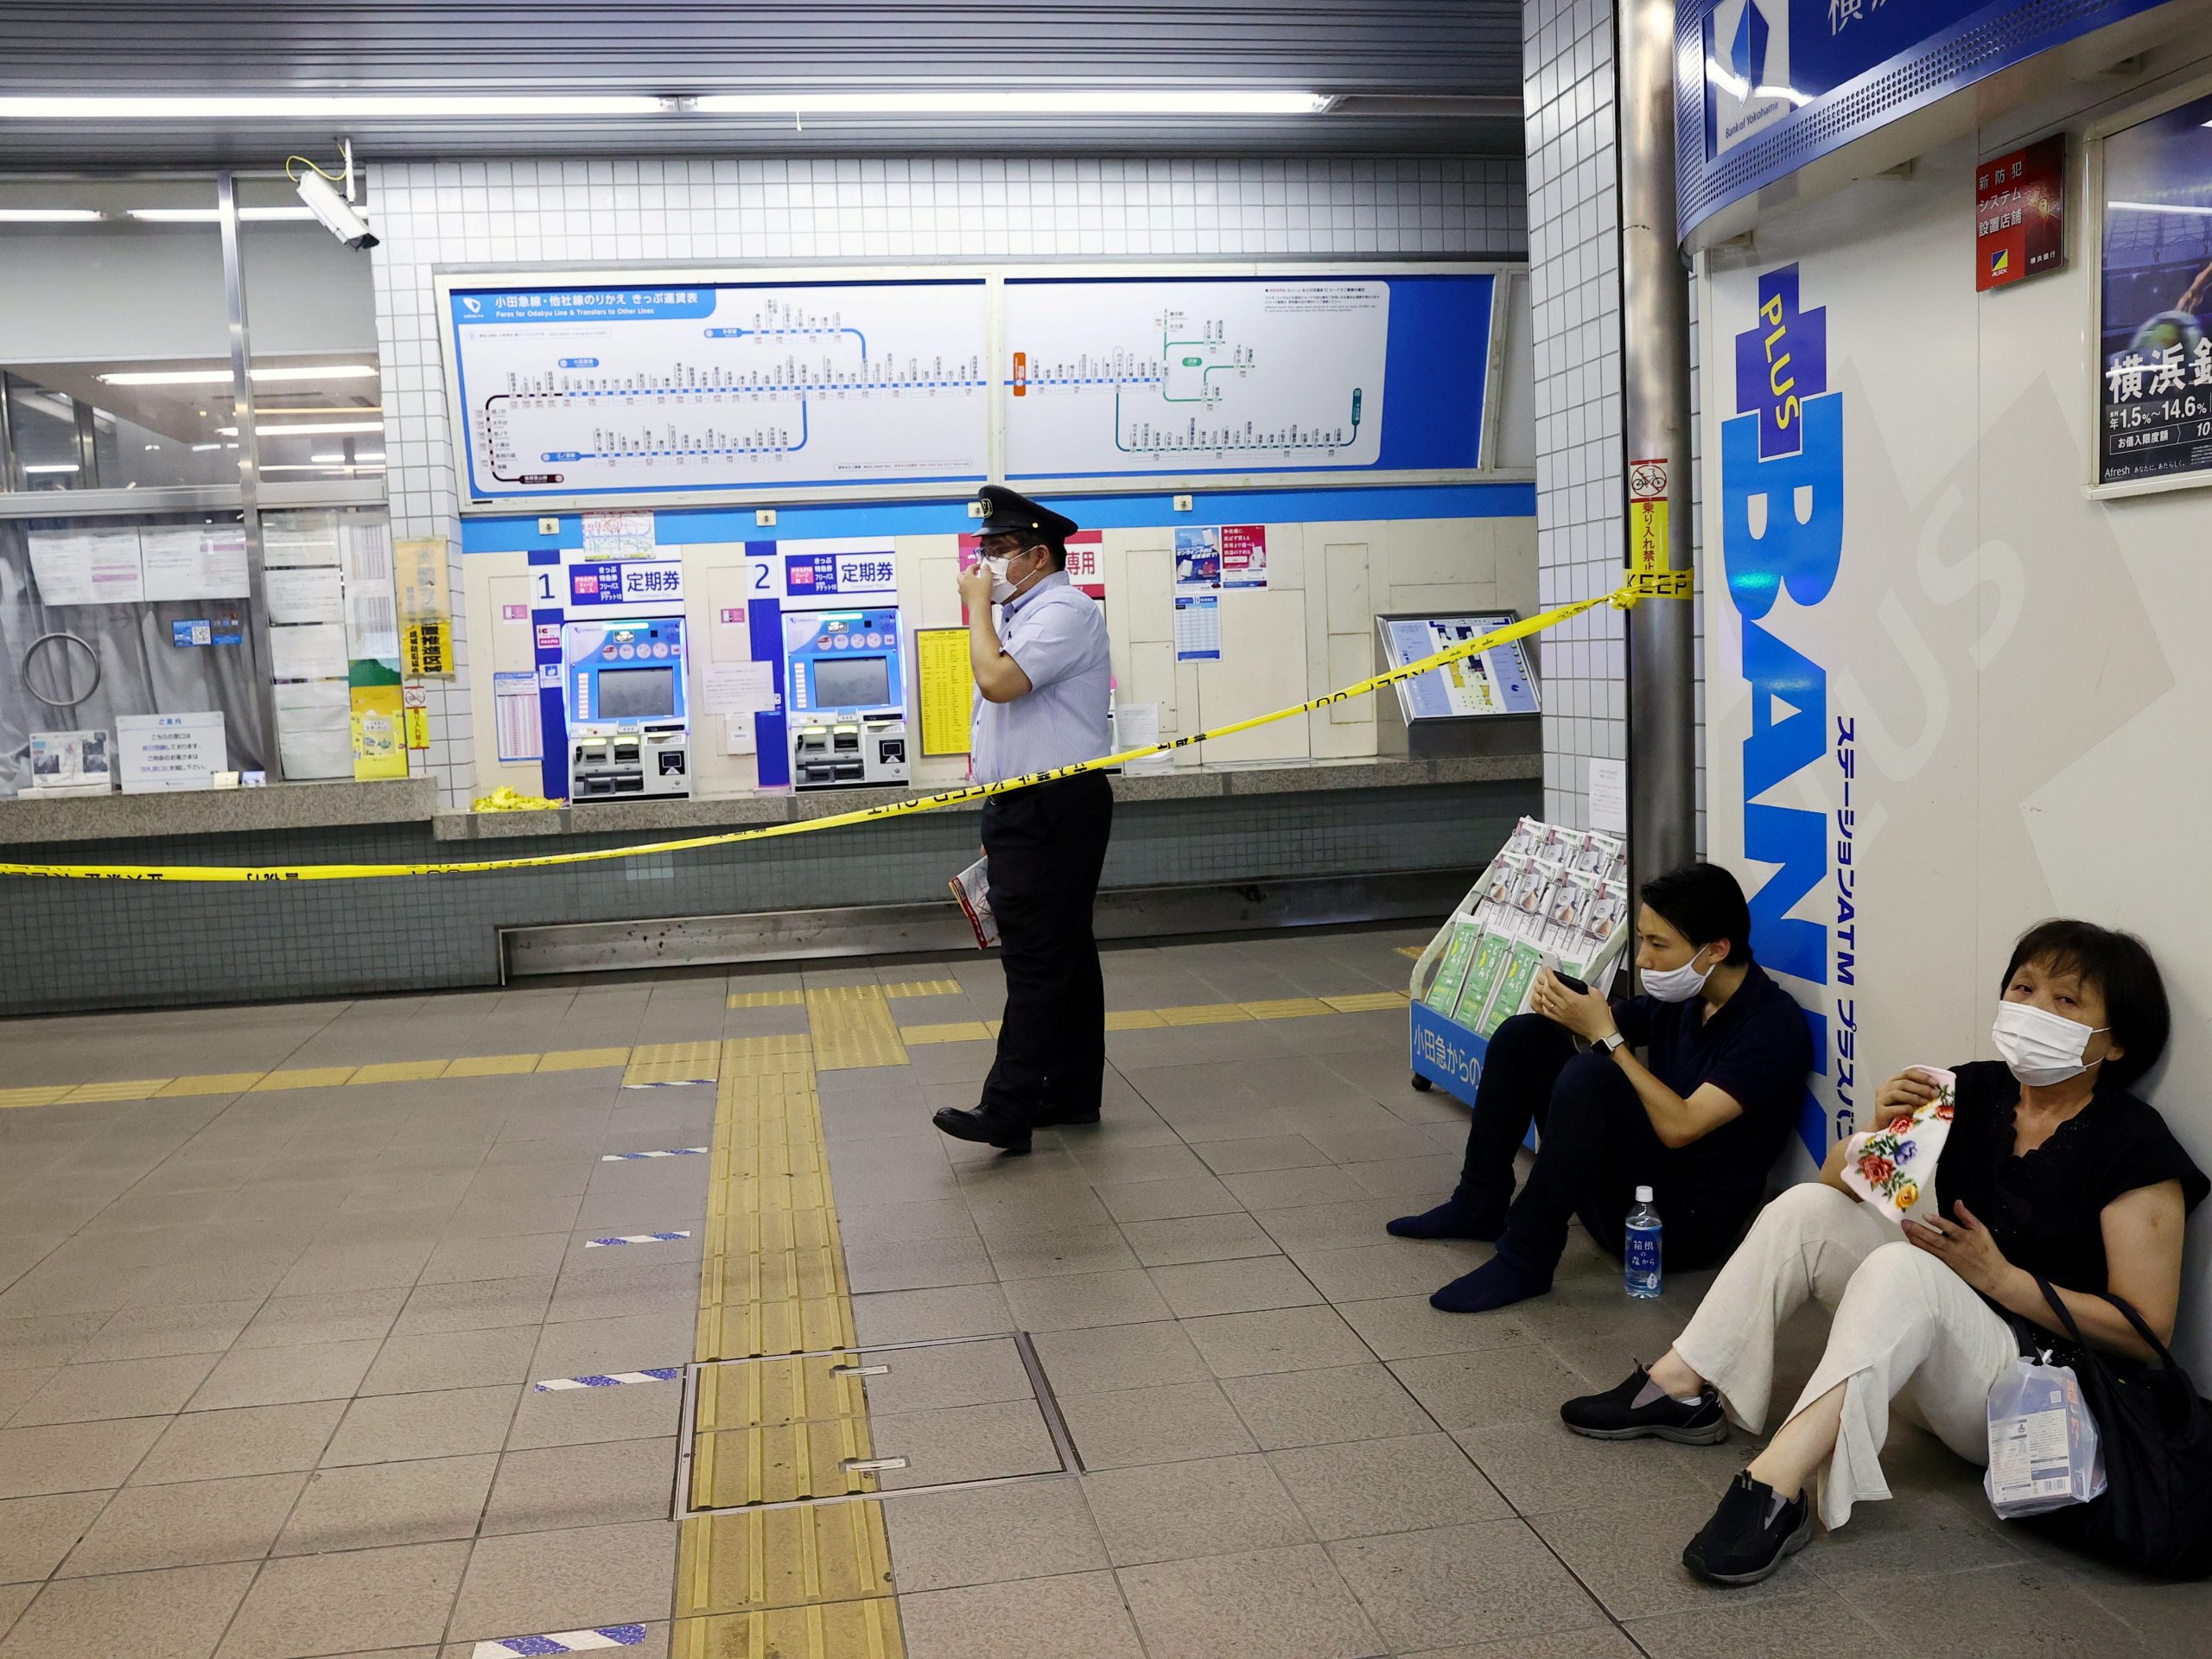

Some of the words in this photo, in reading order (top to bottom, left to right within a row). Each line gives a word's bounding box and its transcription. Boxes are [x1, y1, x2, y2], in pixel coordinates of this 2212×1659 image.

[1726, 123, 1738, 138] Bank
[1739, 117, 1745, 130] of
[1746, 102, 1778, 124] Yokohama
[1979, 162, 2022, 191] 新防犯
[1980, 187, 2022, 213] システム
[1979, 208, 2022, 237] 設置店舗
[527, 309, 553, 319] Odakyu
[576, 308, 607, 317] Transfers
[1760, 292, 1800, 430] PLUS
[2109, 418, 2119, 430] 年
[2118, 430, 2169, 448] お借入限度額
[2196, 422, 2212, 436] 10
[2105, 466, 2131, 478] Afresh
[1643, 502, 1655, 571] 乗り入れ禁止
[842, 563, 893, 583] 定期券
[1067, 551, 1095, 575] 専用
[538, 574, 555, 599] 1
[626, 571, 680, 592] 定期券
[755, 564, 770, 589] 2
[1627, 574, 1687, 595] KEEP
[1837, 716, 1855, 986] ステーションATM
[1633, 1240, 1654, 1250] 箱根
